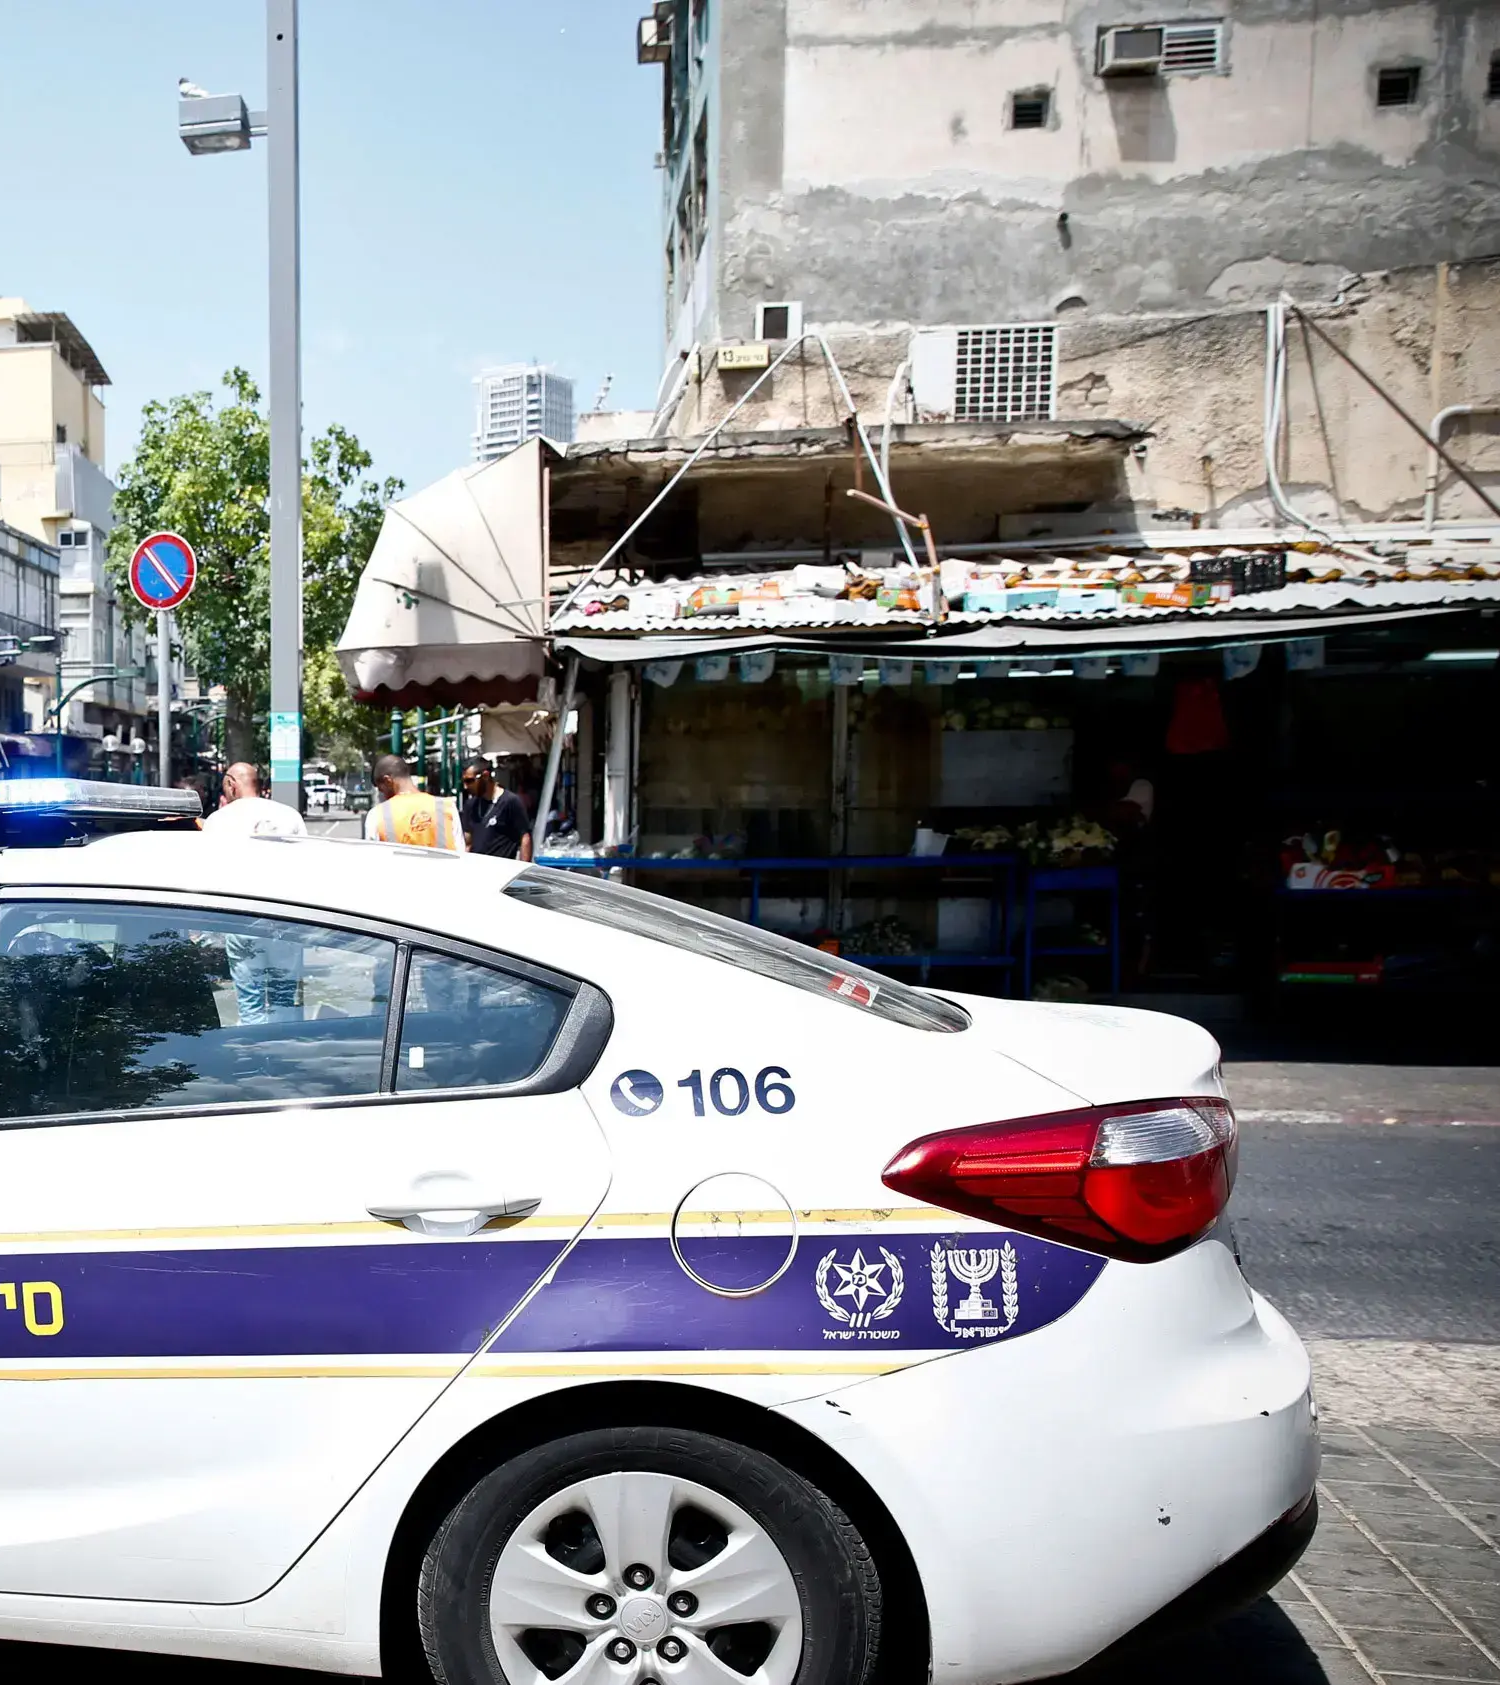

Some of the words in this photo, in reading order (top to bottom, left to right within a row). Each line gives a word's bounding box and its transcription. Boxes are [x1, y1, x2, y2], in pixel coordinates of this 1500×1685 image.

[677, 1065, 796, 1117] 106
[822, 1328, 856, 1340] ישראל
[857, 1330, 900, 1340] משטרת
[950, 1319, 1006, 1339] ישראל
[626, 1604, 661, 1634] KIA
